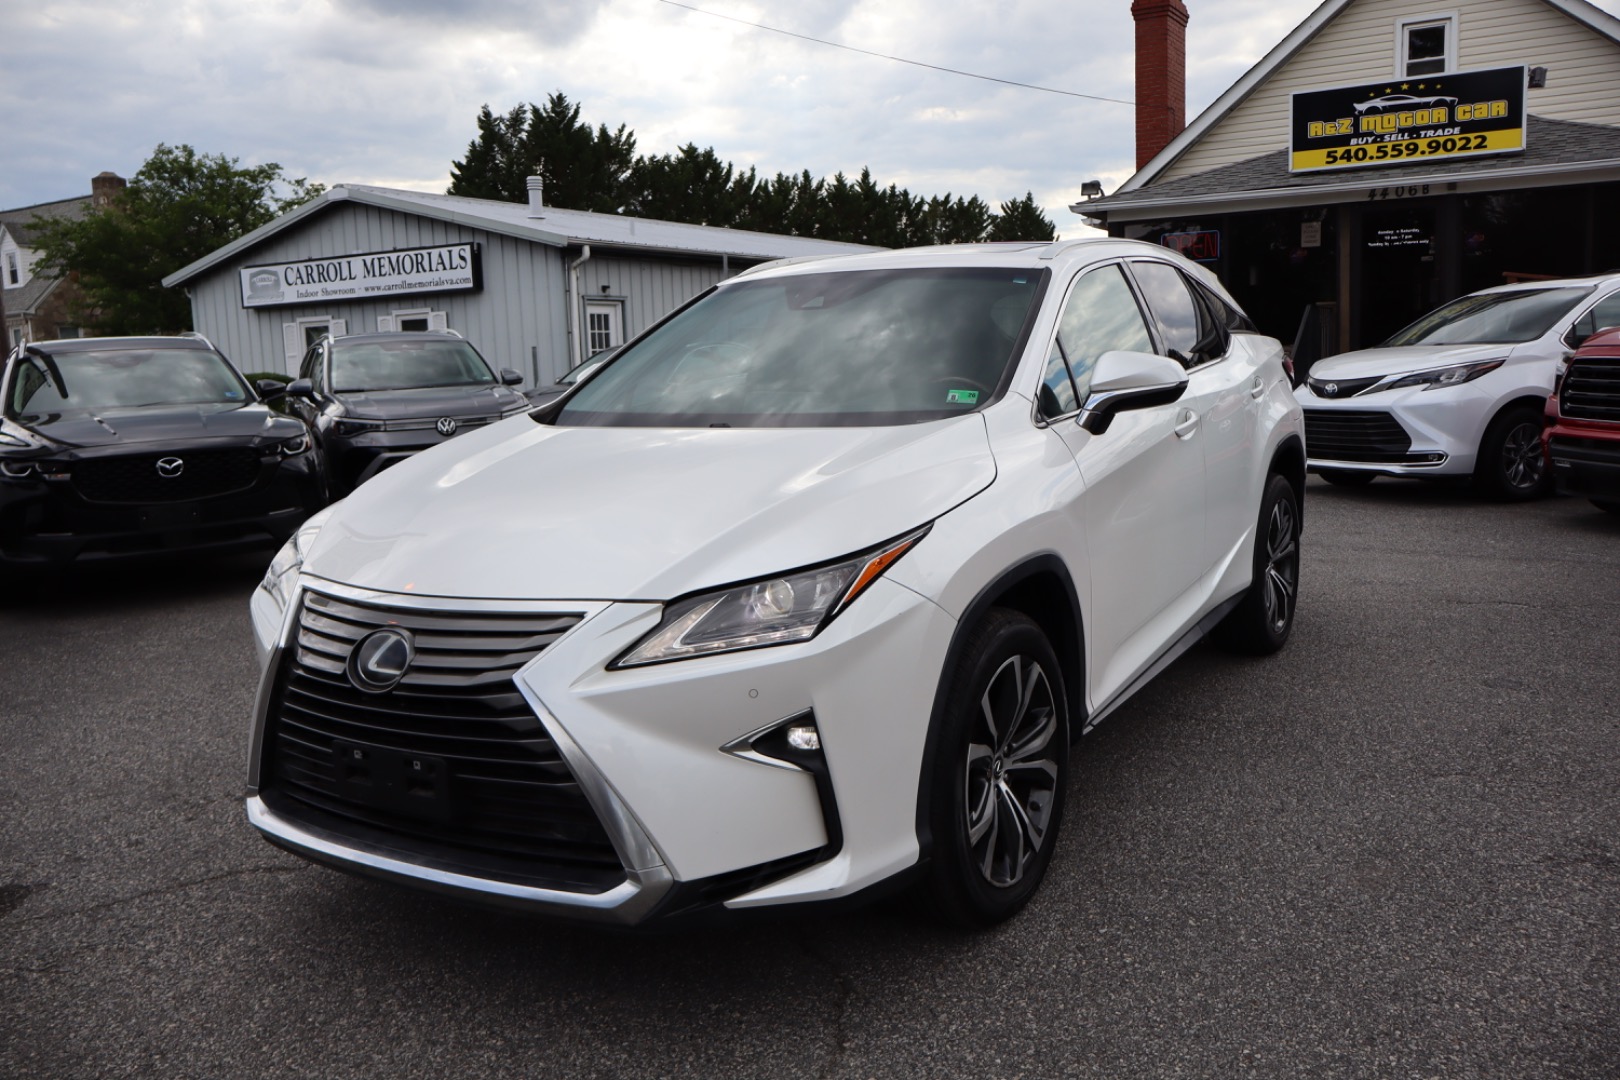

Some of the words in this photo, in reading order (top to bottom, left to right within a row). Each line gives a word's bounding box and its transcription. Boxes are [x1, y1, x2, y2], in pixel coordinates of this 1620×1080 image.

[1307, 117, 1354, 139] A&Z
[1350, 136, 1376, 146] BUY
[1383, 132, 1410, 143] SELL
[1419, 126, 1461, 137] TRADE
[1324, 134, 1488, 165] 540.559.9022
[1164, 232, 1217, 258] OPEN
[284, 260, 357, 287] CARROLL
[362, 247, 468, 279] MEMORIALS
[296, 288, 319, 299] Indoor
[320, 286, 356, 297] Showroom
[364, 275, 472, 293] www.carrollmemorialsva.com
